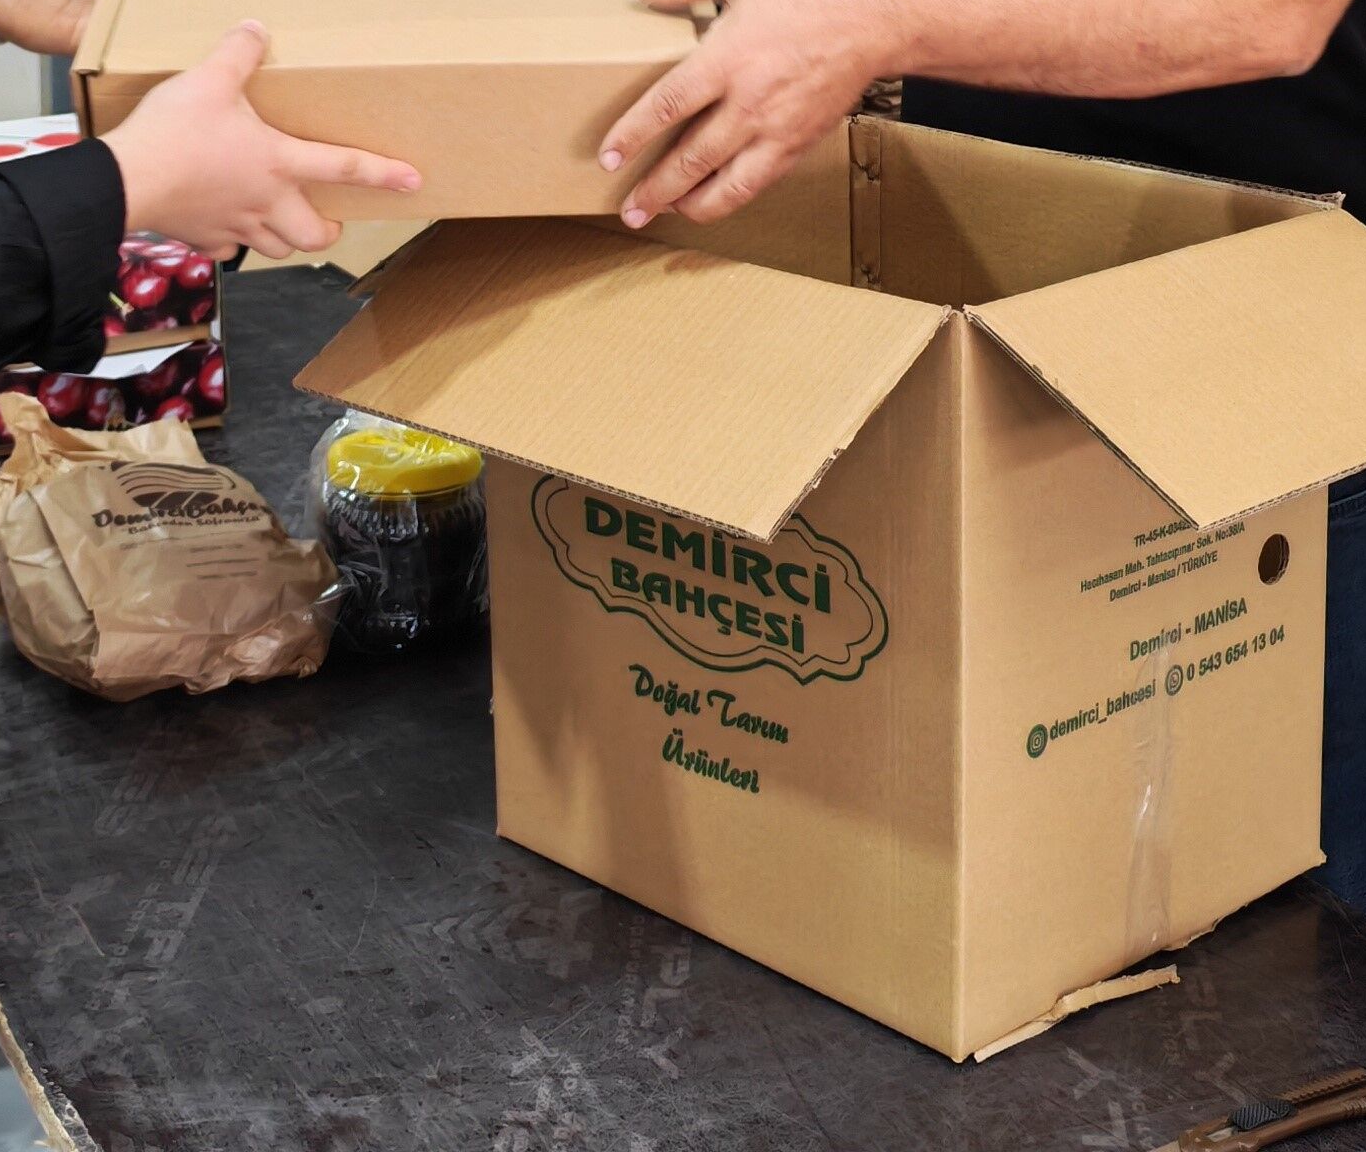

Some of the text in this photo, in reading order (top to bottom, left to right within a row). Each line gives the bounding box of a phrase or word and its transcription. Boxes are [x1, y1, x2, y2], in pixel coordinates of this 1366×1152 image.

[584, 495, 831, 614] DEMİRCİ
[1109, 579, 1141, 602] Demirci
[1147, 569, 1176, 588] Manisa
[1182, 550, 1219, 574] TÜRKİYE
[1125, 560, 1145, 577] Mah.
[1196, 535, 1214, 550] Sok.
[611, 557, 805, 654] BAHÇESİ
[1129, 623, 1182, 662] Demirci
[1194, 597, 1248, 635] MANİSA
[1186, 663, 1195, 682] 0
[1198, 651, 1222, 678] 543
[1225, 639, 1248, 666] 654
[1251, 632, 1266, 654] 13
[1270, 624, 1286, 647] 04
[628, 663, 789, 744] Doğal Tarım
[662, 728, 760, 794] Ürünleri
